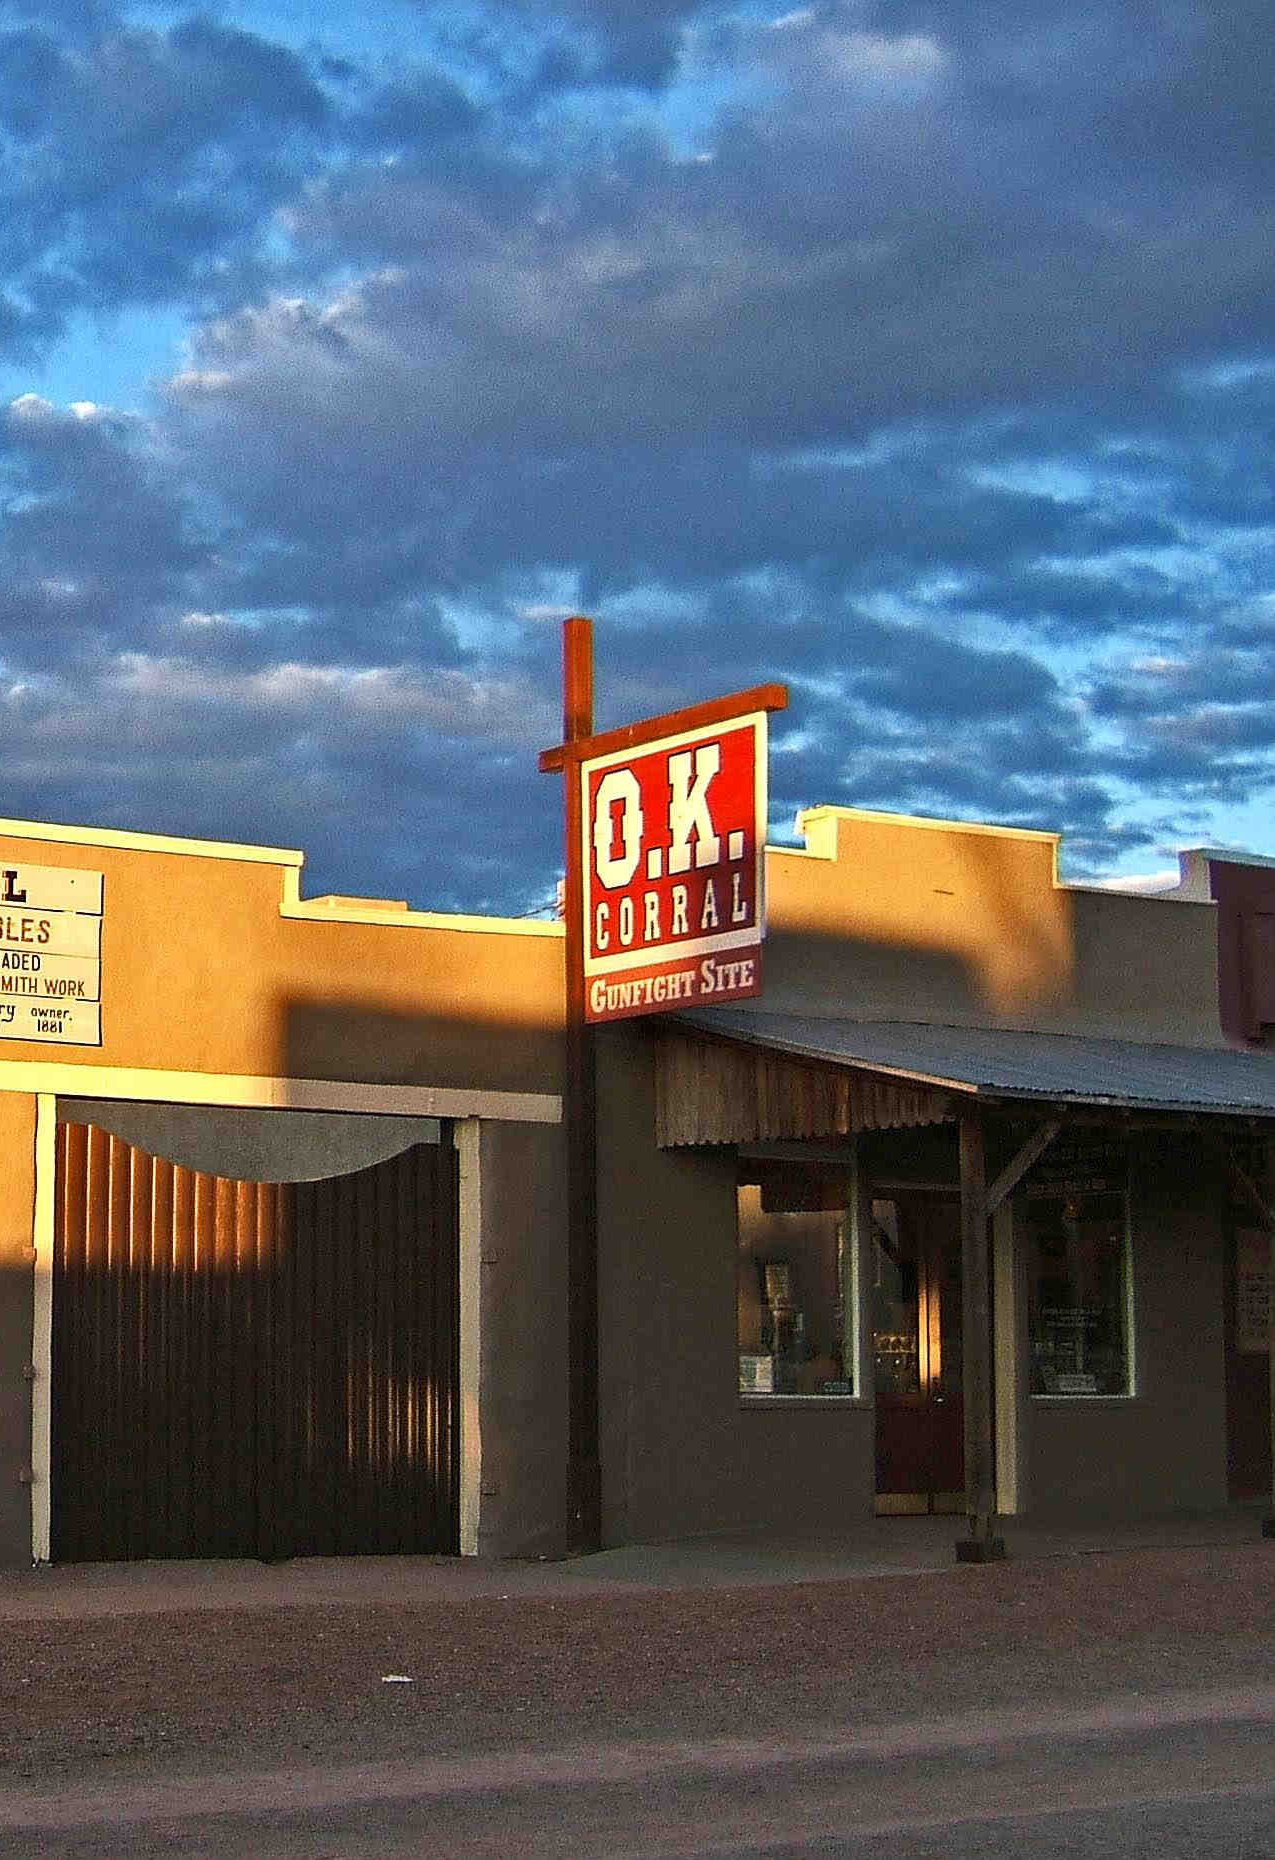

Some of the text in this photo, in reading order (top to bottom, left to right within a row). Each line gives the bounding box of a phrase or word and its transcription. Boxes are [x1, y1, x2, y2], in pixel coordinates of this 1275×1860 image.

[594, 741, 745, 891] O.K.
[595, 872, 747, 951] CORRAL
[44, 979, 86, 997] WORK
[590, 957, 754, 1013] GUNFIGHT SITE
[37, 1019, 63, 1033] 1881
